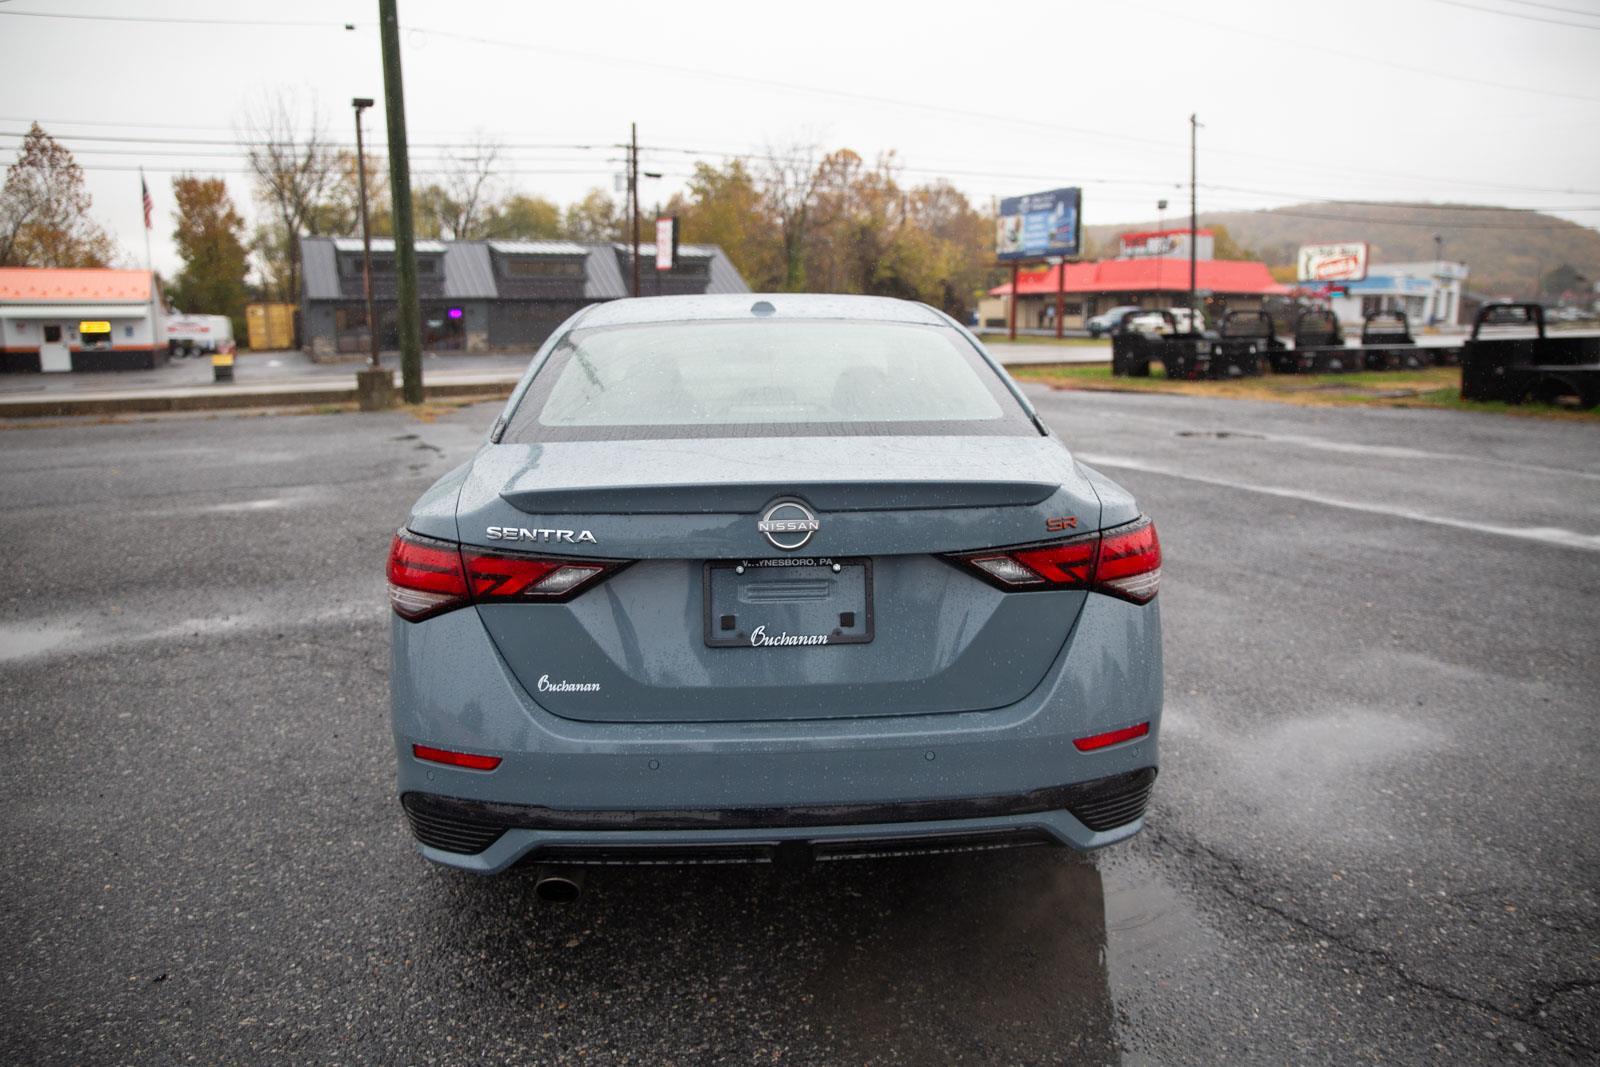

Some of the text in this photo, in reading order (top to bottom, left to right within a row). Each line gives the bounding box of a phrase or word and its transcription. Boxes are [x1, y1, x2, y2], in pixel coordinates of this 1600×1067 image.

[759, 522, 819, 530] NISSAN
[1047, 515, 1077, 531] SR
[486, 526, 597, 543] SENTRA
[751, 625, 828, 646] Buchanan
[537, 674, 600, 692] Buchanan
